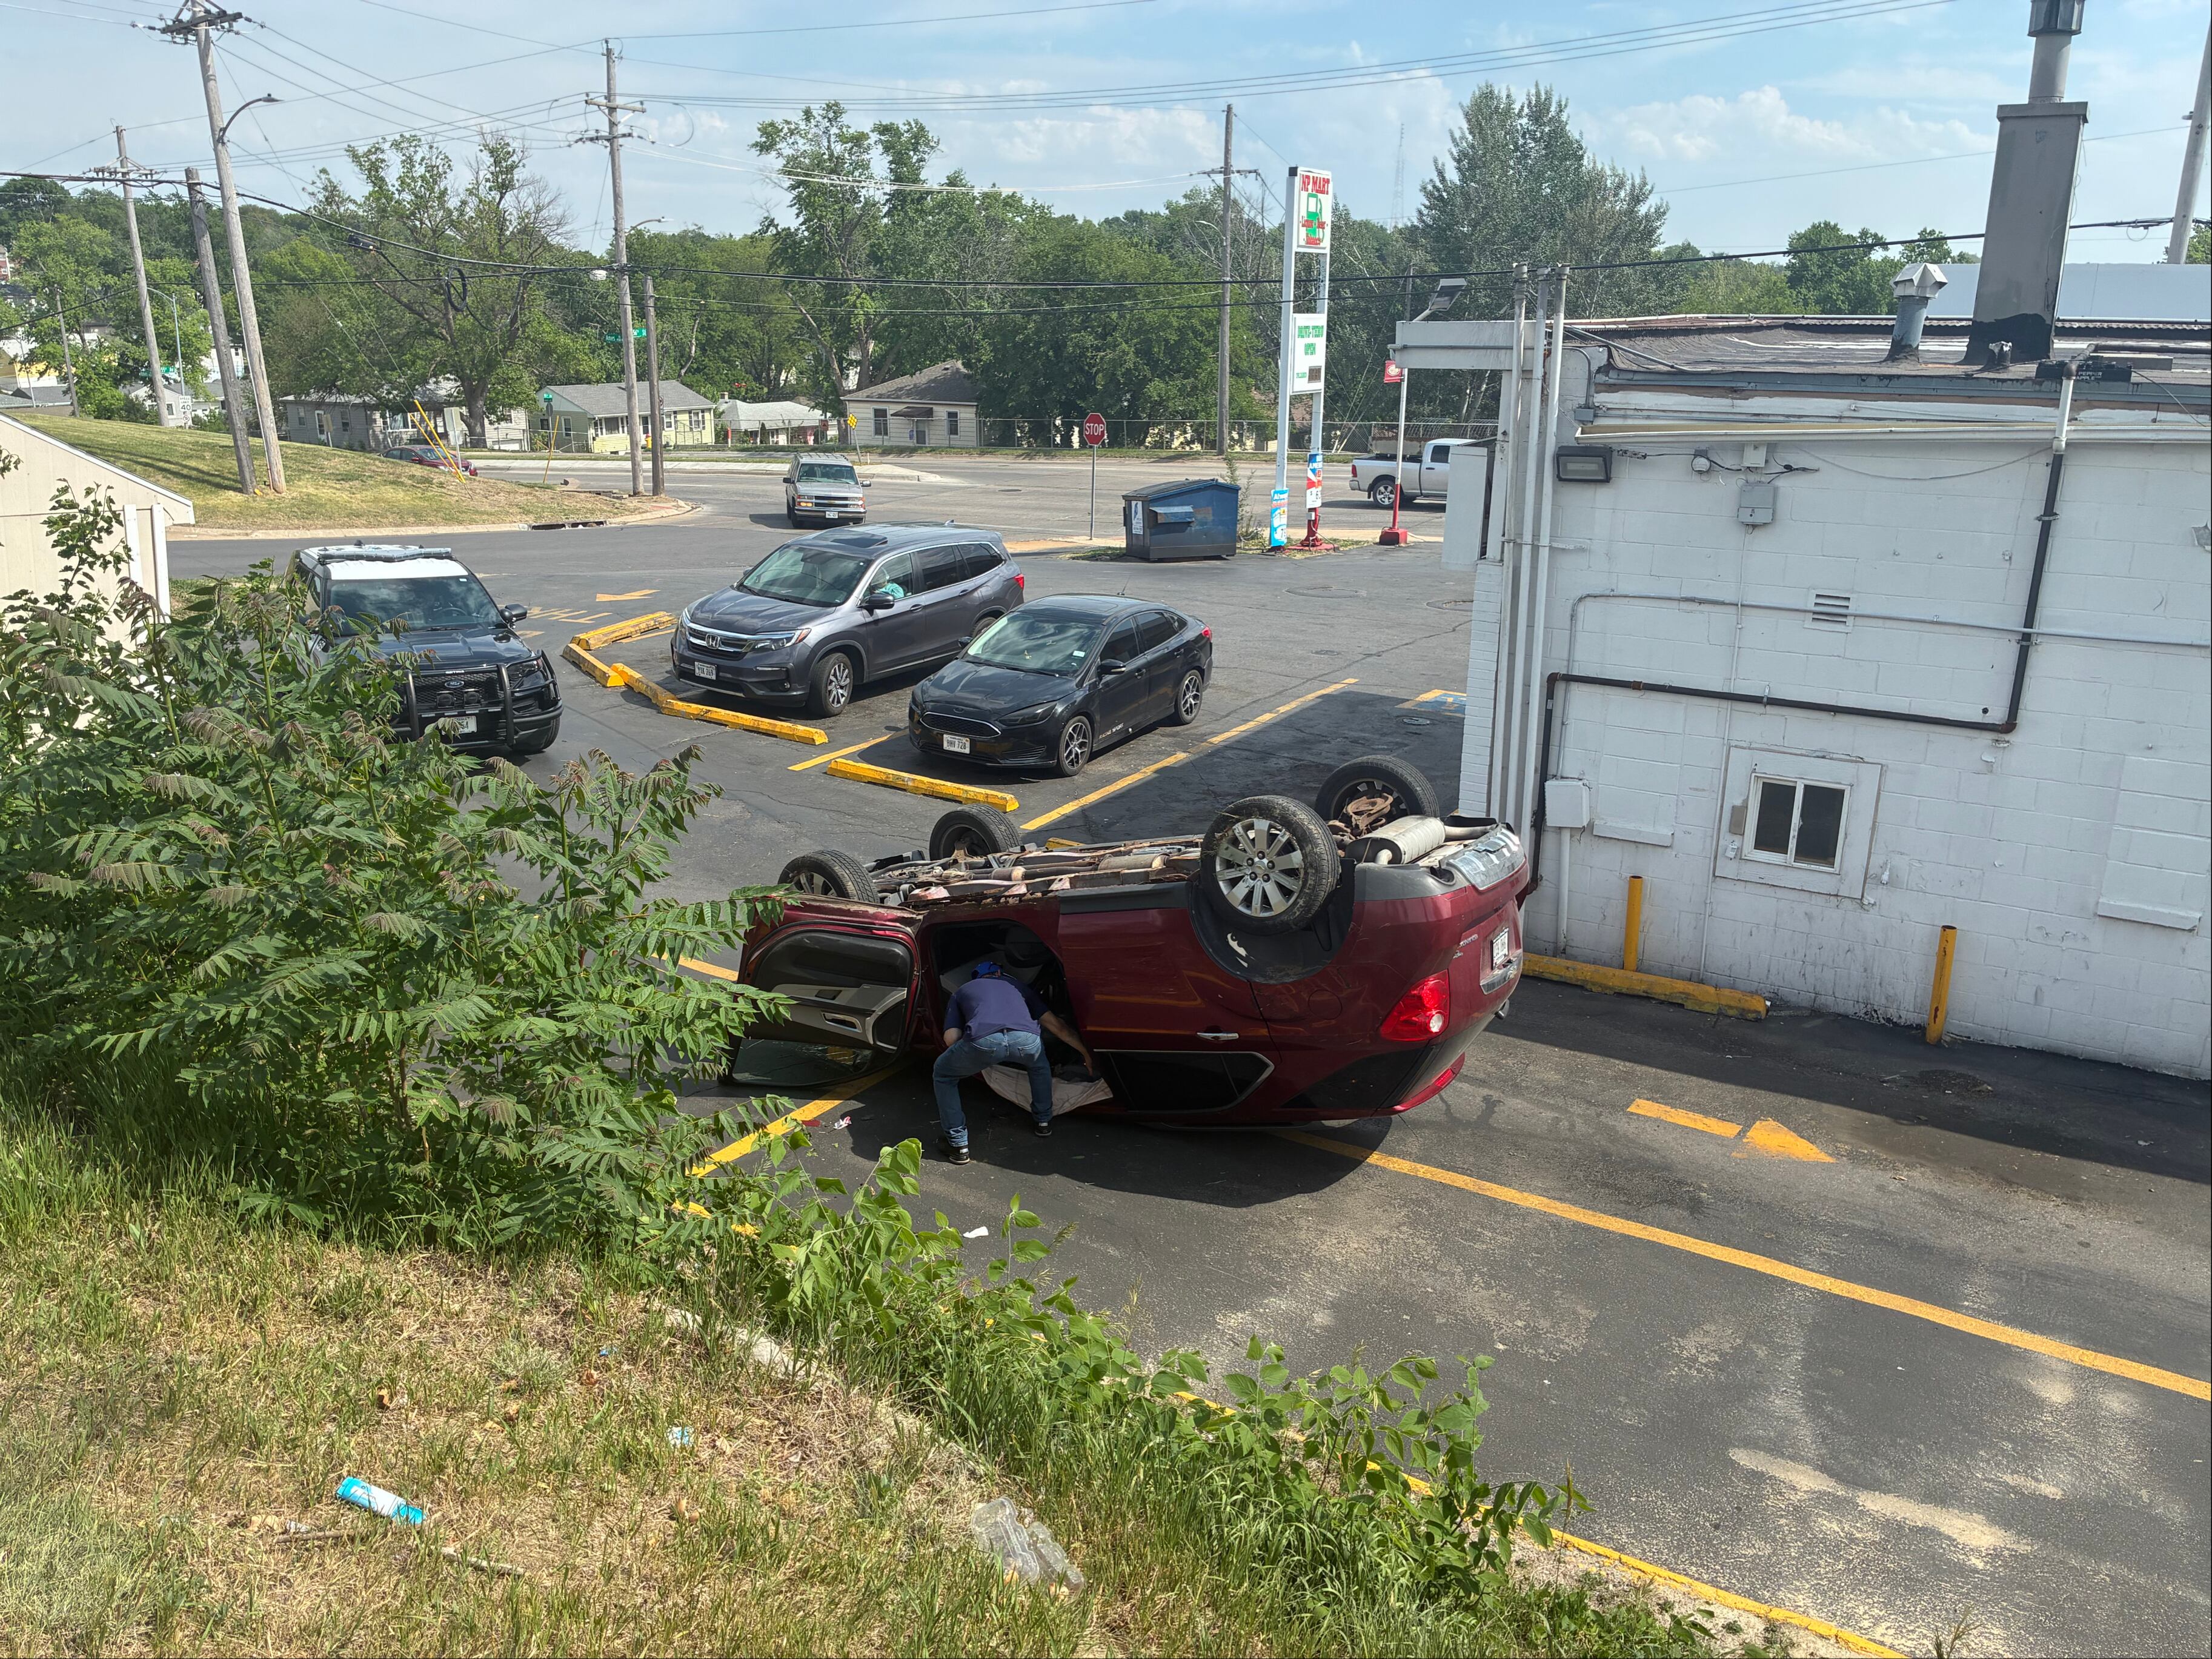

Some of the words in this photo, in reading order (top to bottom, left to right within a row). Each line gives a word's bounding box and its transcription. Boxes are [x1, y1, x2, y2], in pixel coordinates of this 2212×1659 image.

[1301, 174, 1310, 192] NP
[1311, 176, 1330, 195] MART
[1085, 423, 1104, 436] STOP
[1112, 722, 1124, 733] SPORT
[947, 739, 956, 748] BHV
[957, 740, 966, 750] 728
